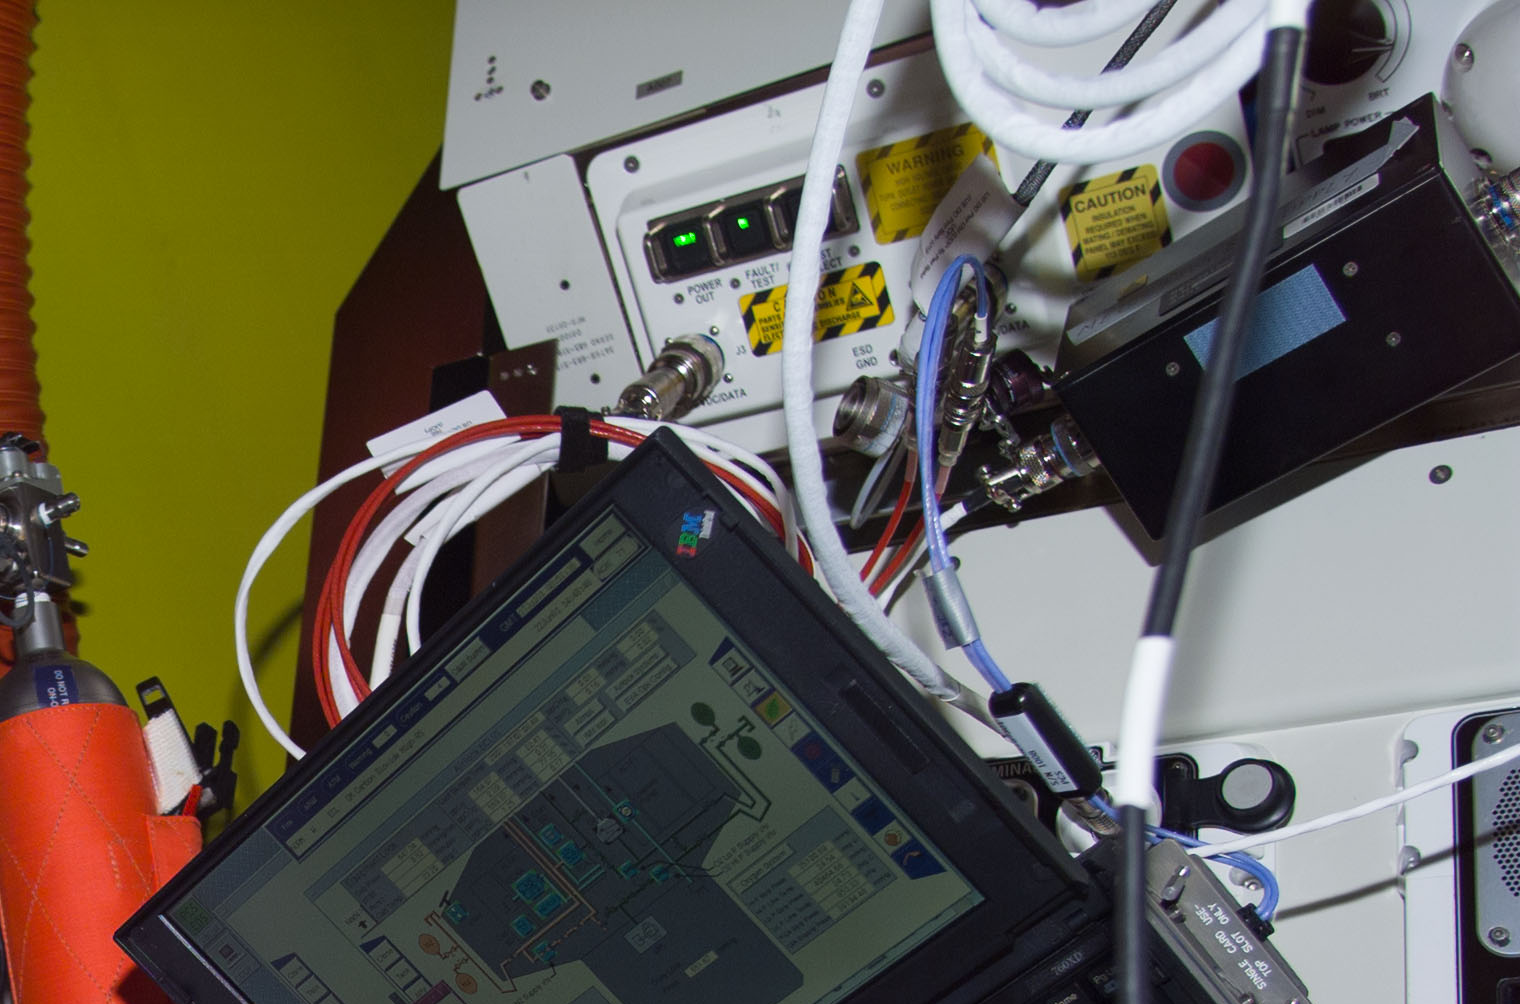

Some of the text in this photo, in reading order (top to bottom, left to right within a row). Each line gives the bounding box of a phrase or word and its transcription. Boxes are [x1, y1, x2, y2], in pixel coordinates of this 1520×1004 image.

[887, 144, 965, 175] WARNING
[1074, 183, 1146, 214] CAUTION
[745, 262, 779, 280] FAULT/
[687, 278, 723, 296] POWER
[751, 275, 776, 289] TEST
[695, 291, 716, 305] OUT
[853, 344, 873, 358] ESD
[856, 356, 878, 370] GND
[57, 680, 67, 695] NOT
[1208, 903, 1272, 977] TOP SLOT ONLY
[1215, 930, 1237, 953] CARD
[1051, 951, 1083, 976] 760XD
[1238, 959, 1267, 990] SINGLE
